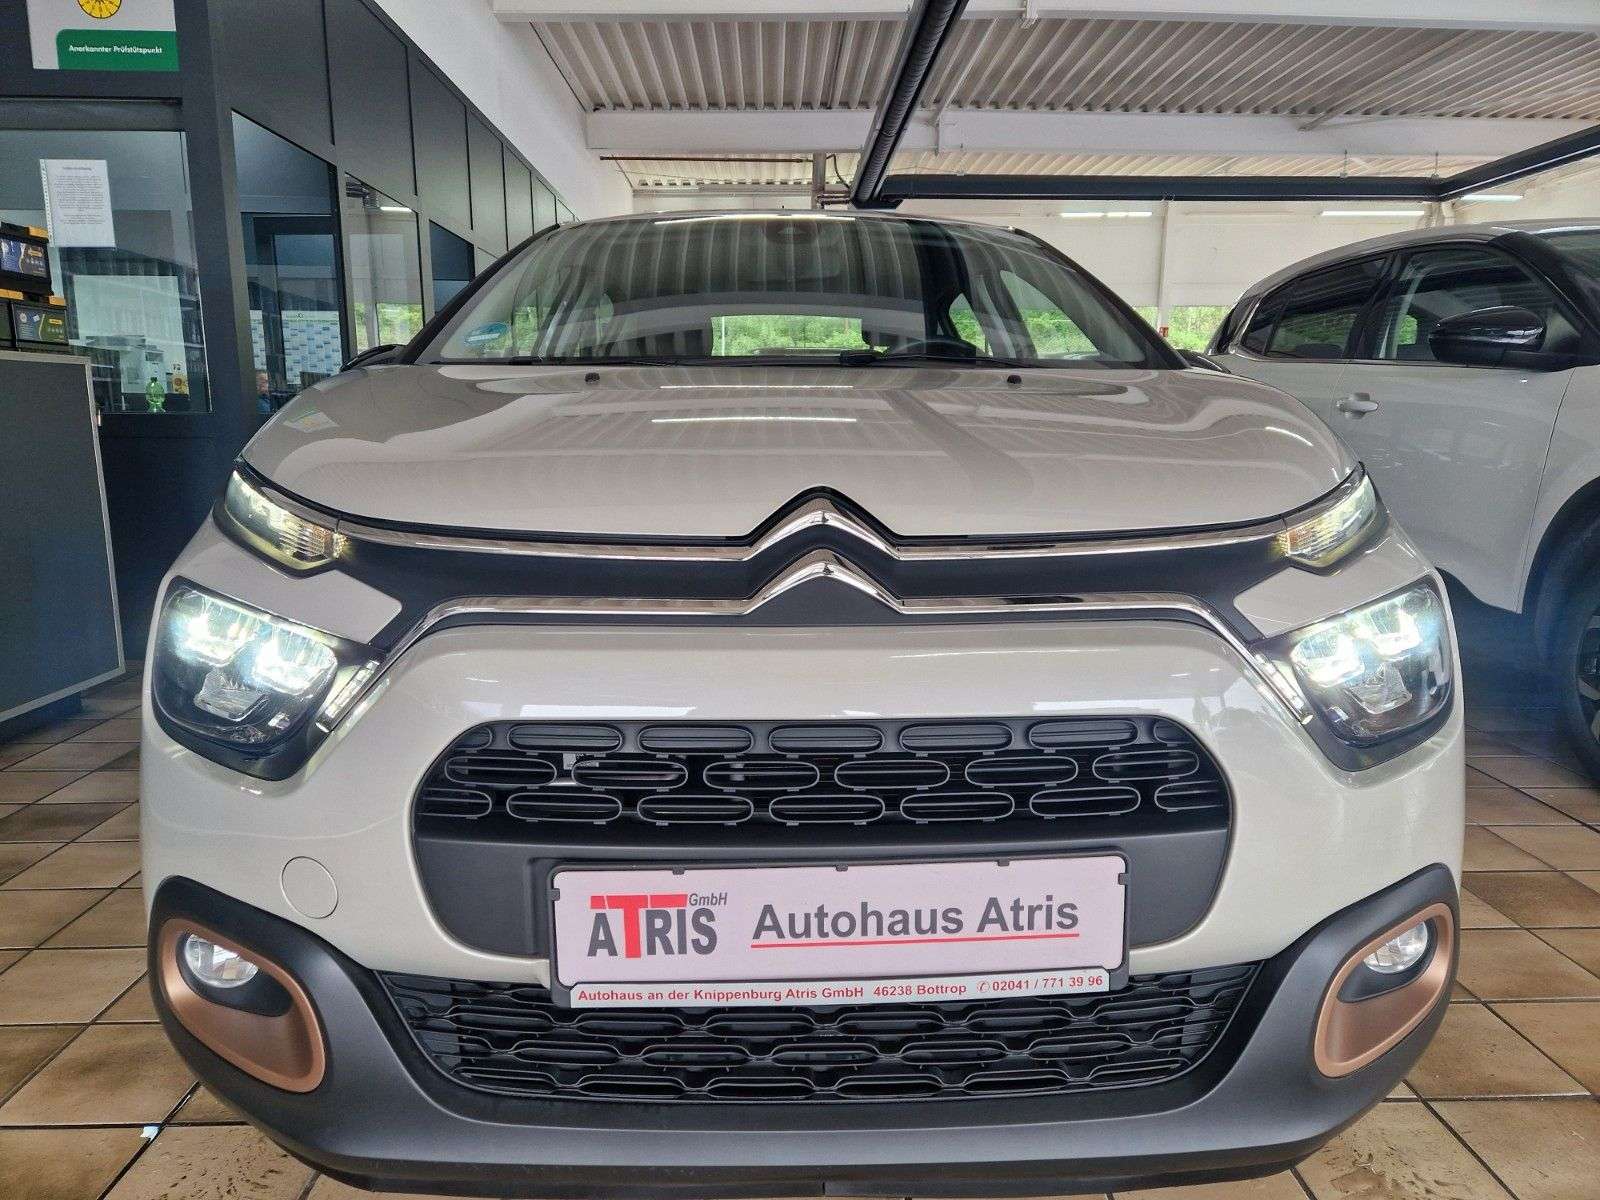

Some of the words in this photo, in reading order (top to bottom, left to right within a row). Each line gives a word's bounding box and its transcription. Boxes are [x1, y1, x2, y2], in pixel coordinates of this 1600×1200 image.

[68, 45, 112, 53] Anerkannter
[688, 892, 728, 907] GmbH
[587, 894, 718, 959] ATRIS
[752, 901, 964, 940] Autohaus
[976, 894, 1079, 933] Atris
[578, 989, 643, 1001] Autohaus
[647, 991, 664, 1000] an
[667, 989, 689, 1000] der
[694, 988, 782, 1002] Knippenburg
[785, 987, 818, 999] Atris
[821, 986, 864, 998] GmbH
[873, 984, 912, 997] 46238
[917, 983, 967, 996] Bottrop
[992, 979, 1030, 992] 02041
[1042, 977, 1064, 989] 771
[1069, 976, 1084, 988] 39
[1087, 975, 1103, 987] 96
